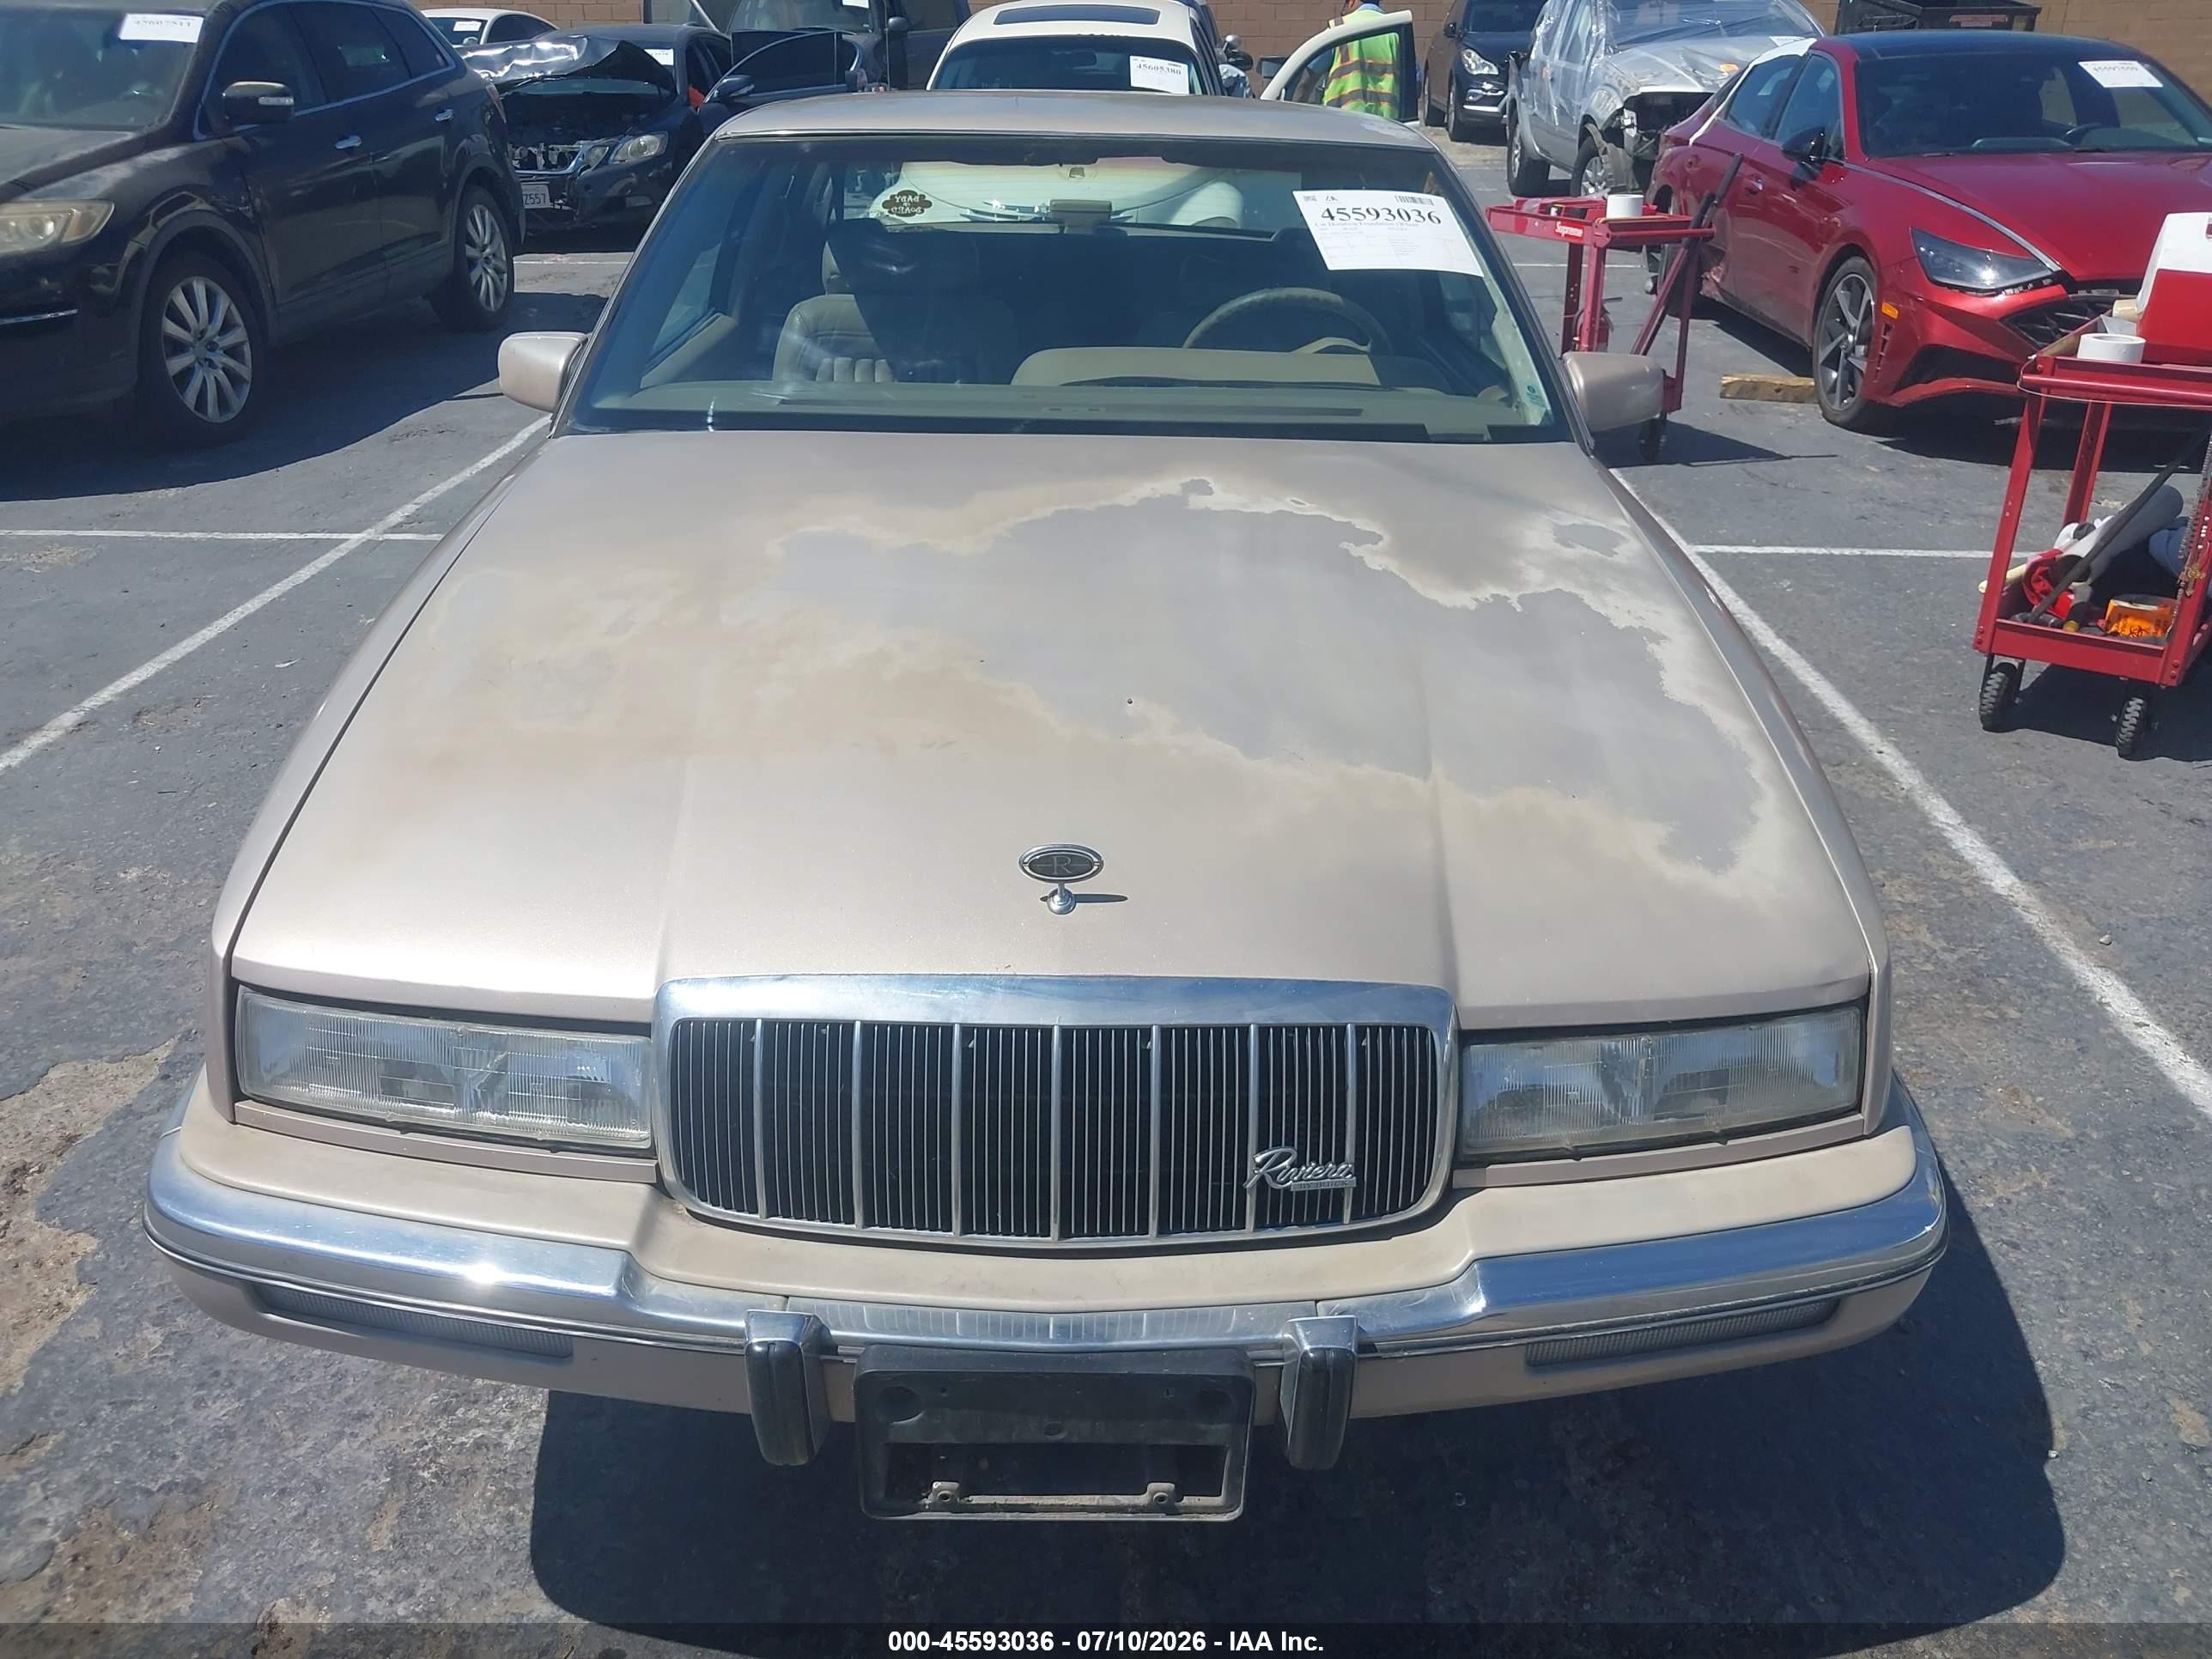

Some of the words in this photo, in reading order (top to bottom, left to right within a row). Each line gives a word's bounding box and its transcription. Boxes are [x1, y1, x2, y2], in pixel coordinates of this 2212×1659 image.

[1321, 207, 1443, 226] 45593036
[1051, 855, 1073, 875] R
[1243, 1146, 1353, 1188] Riviera
